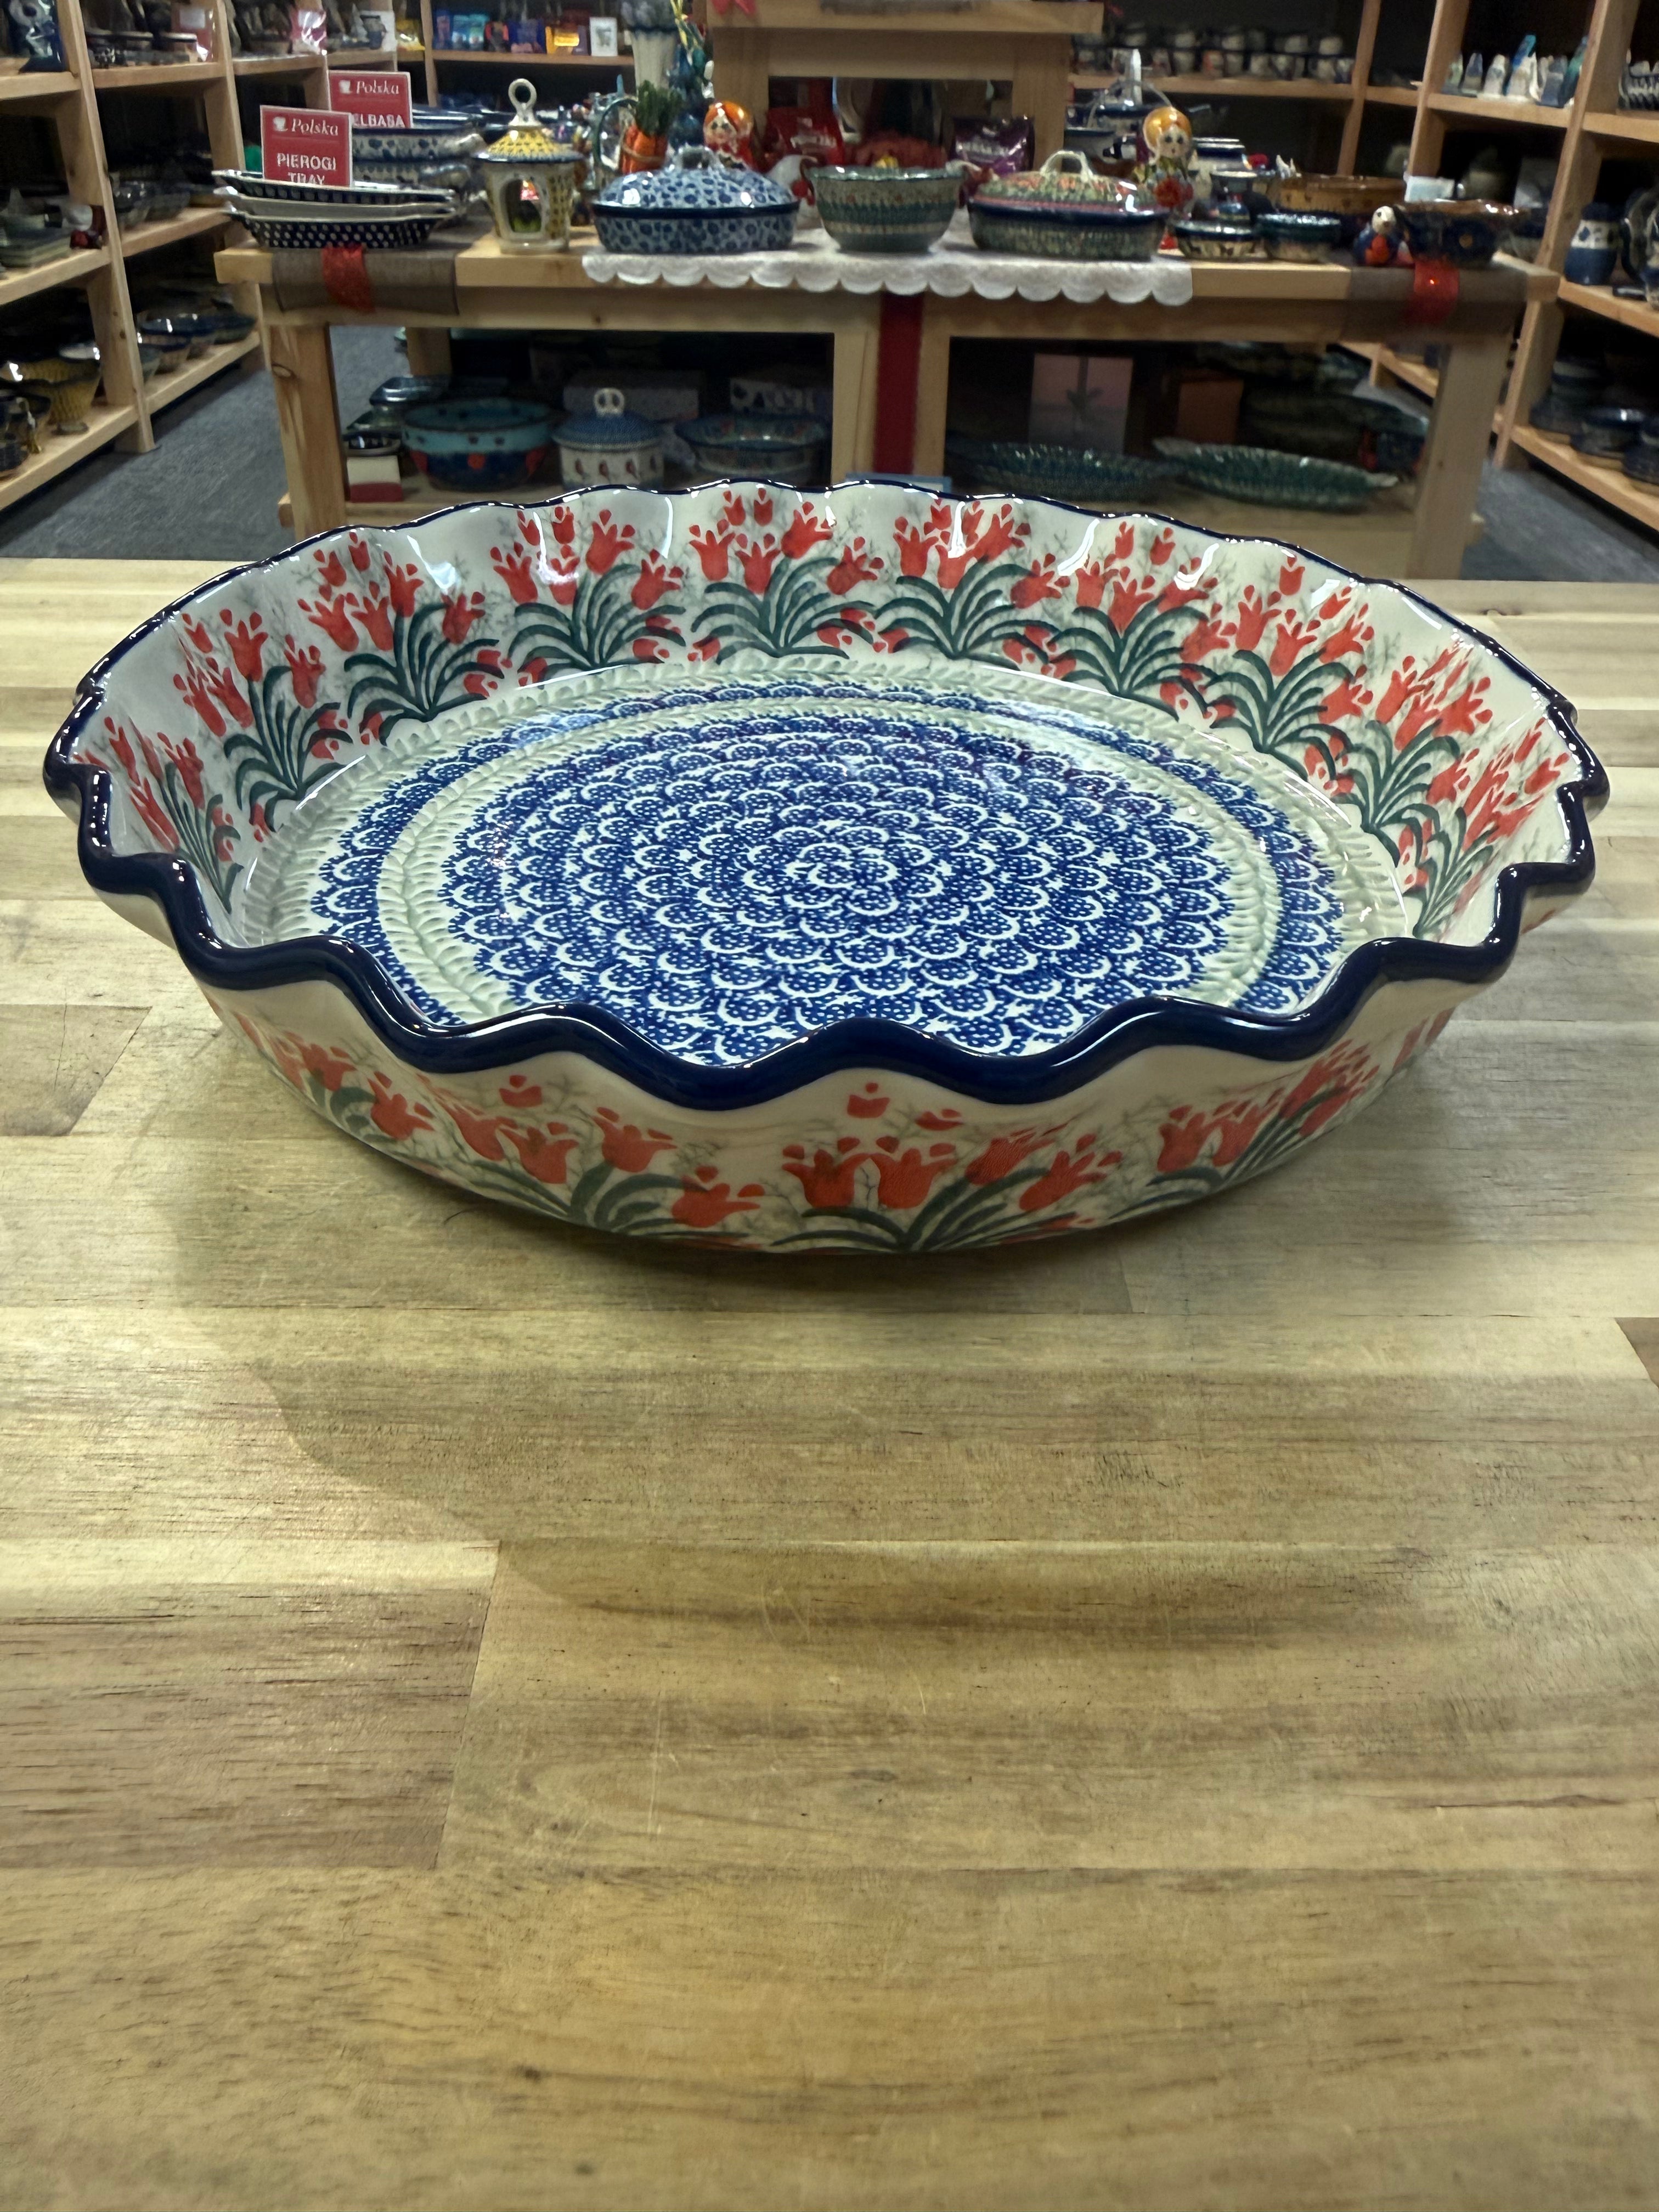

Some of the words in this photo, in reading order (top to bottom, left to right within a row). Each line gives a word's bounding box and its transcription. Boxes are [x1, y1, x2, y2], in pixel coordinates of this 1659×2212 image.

[291, 118, 338, 136] Polska
[276, 153, 336, 171] PIEROGI
[287, 172, 325, 185] TRAY
